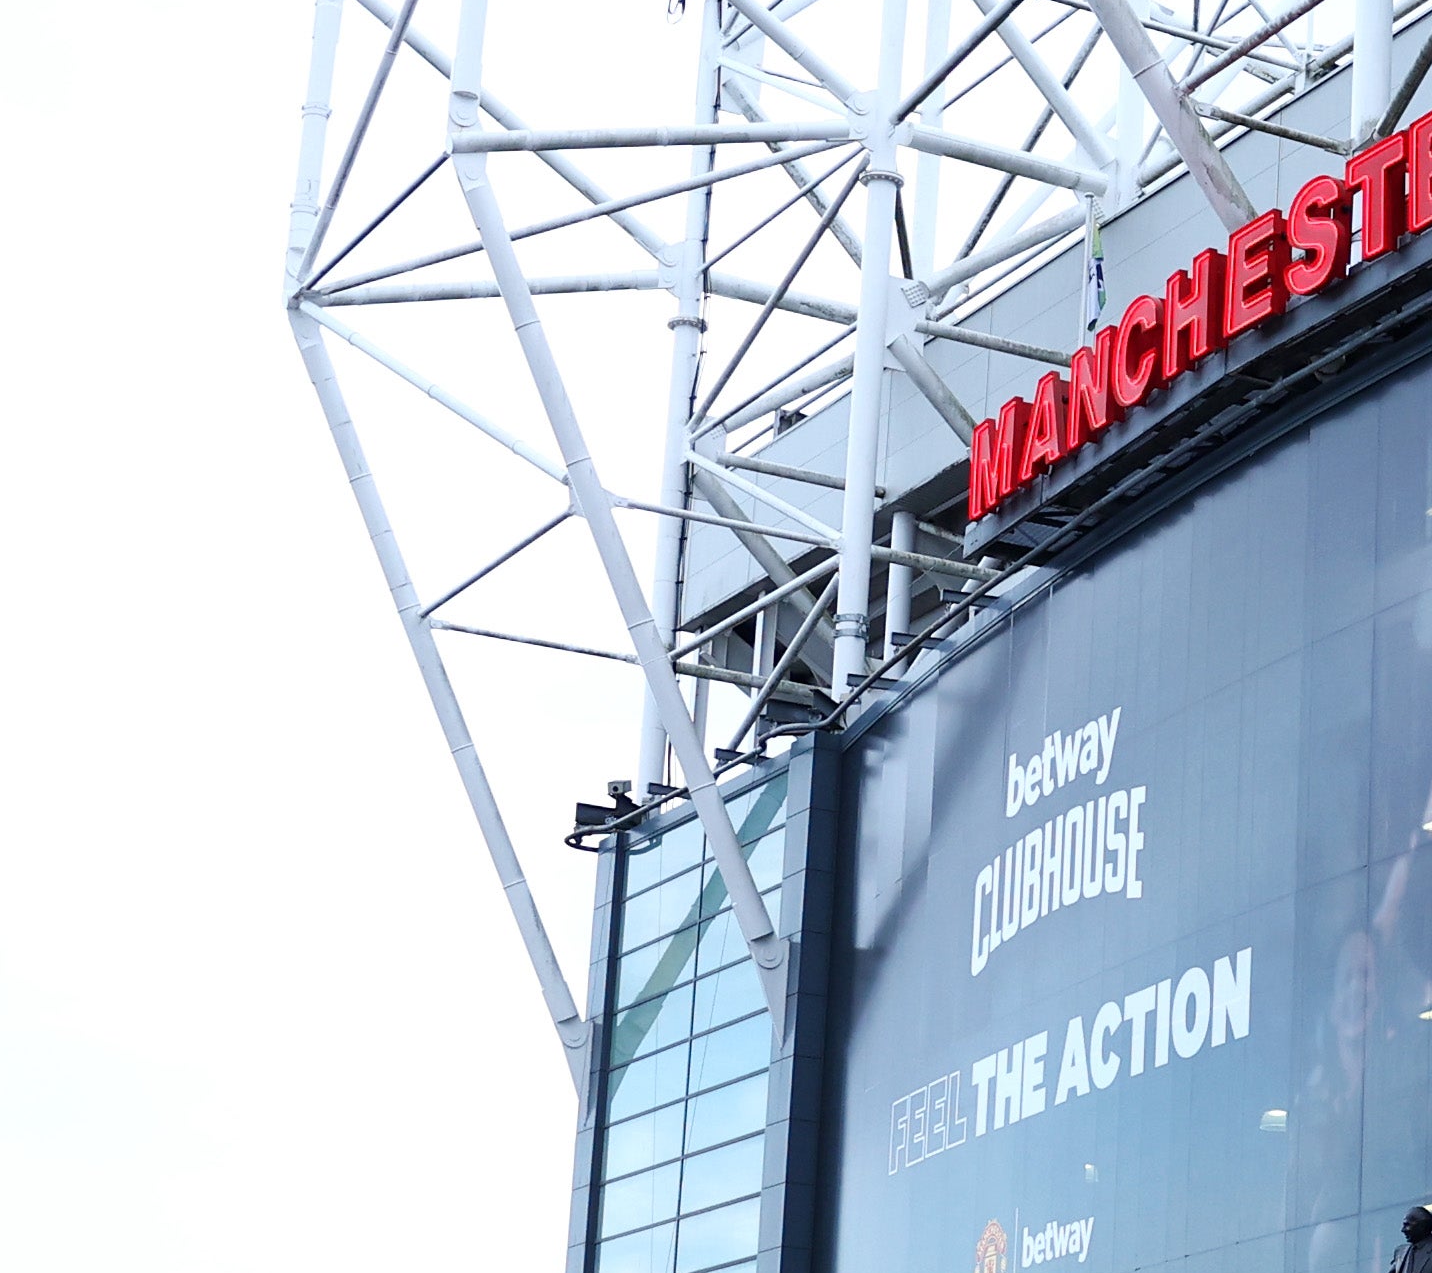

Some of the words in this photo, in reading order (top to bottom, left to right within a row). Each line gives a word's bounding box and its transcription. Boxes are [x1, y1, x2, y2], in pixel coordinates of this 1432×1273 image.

[1006, 707, 1122, 818] betway
[971, 785, 1146, 977] CLUBHOUSE
[888, 1070, 968, 1176] FEEL
[972, 1030, 1048, 1138] THE
[1054, 946, 1252, 1106] ACTION
[1021, 1216, 1095, 1268] betway
